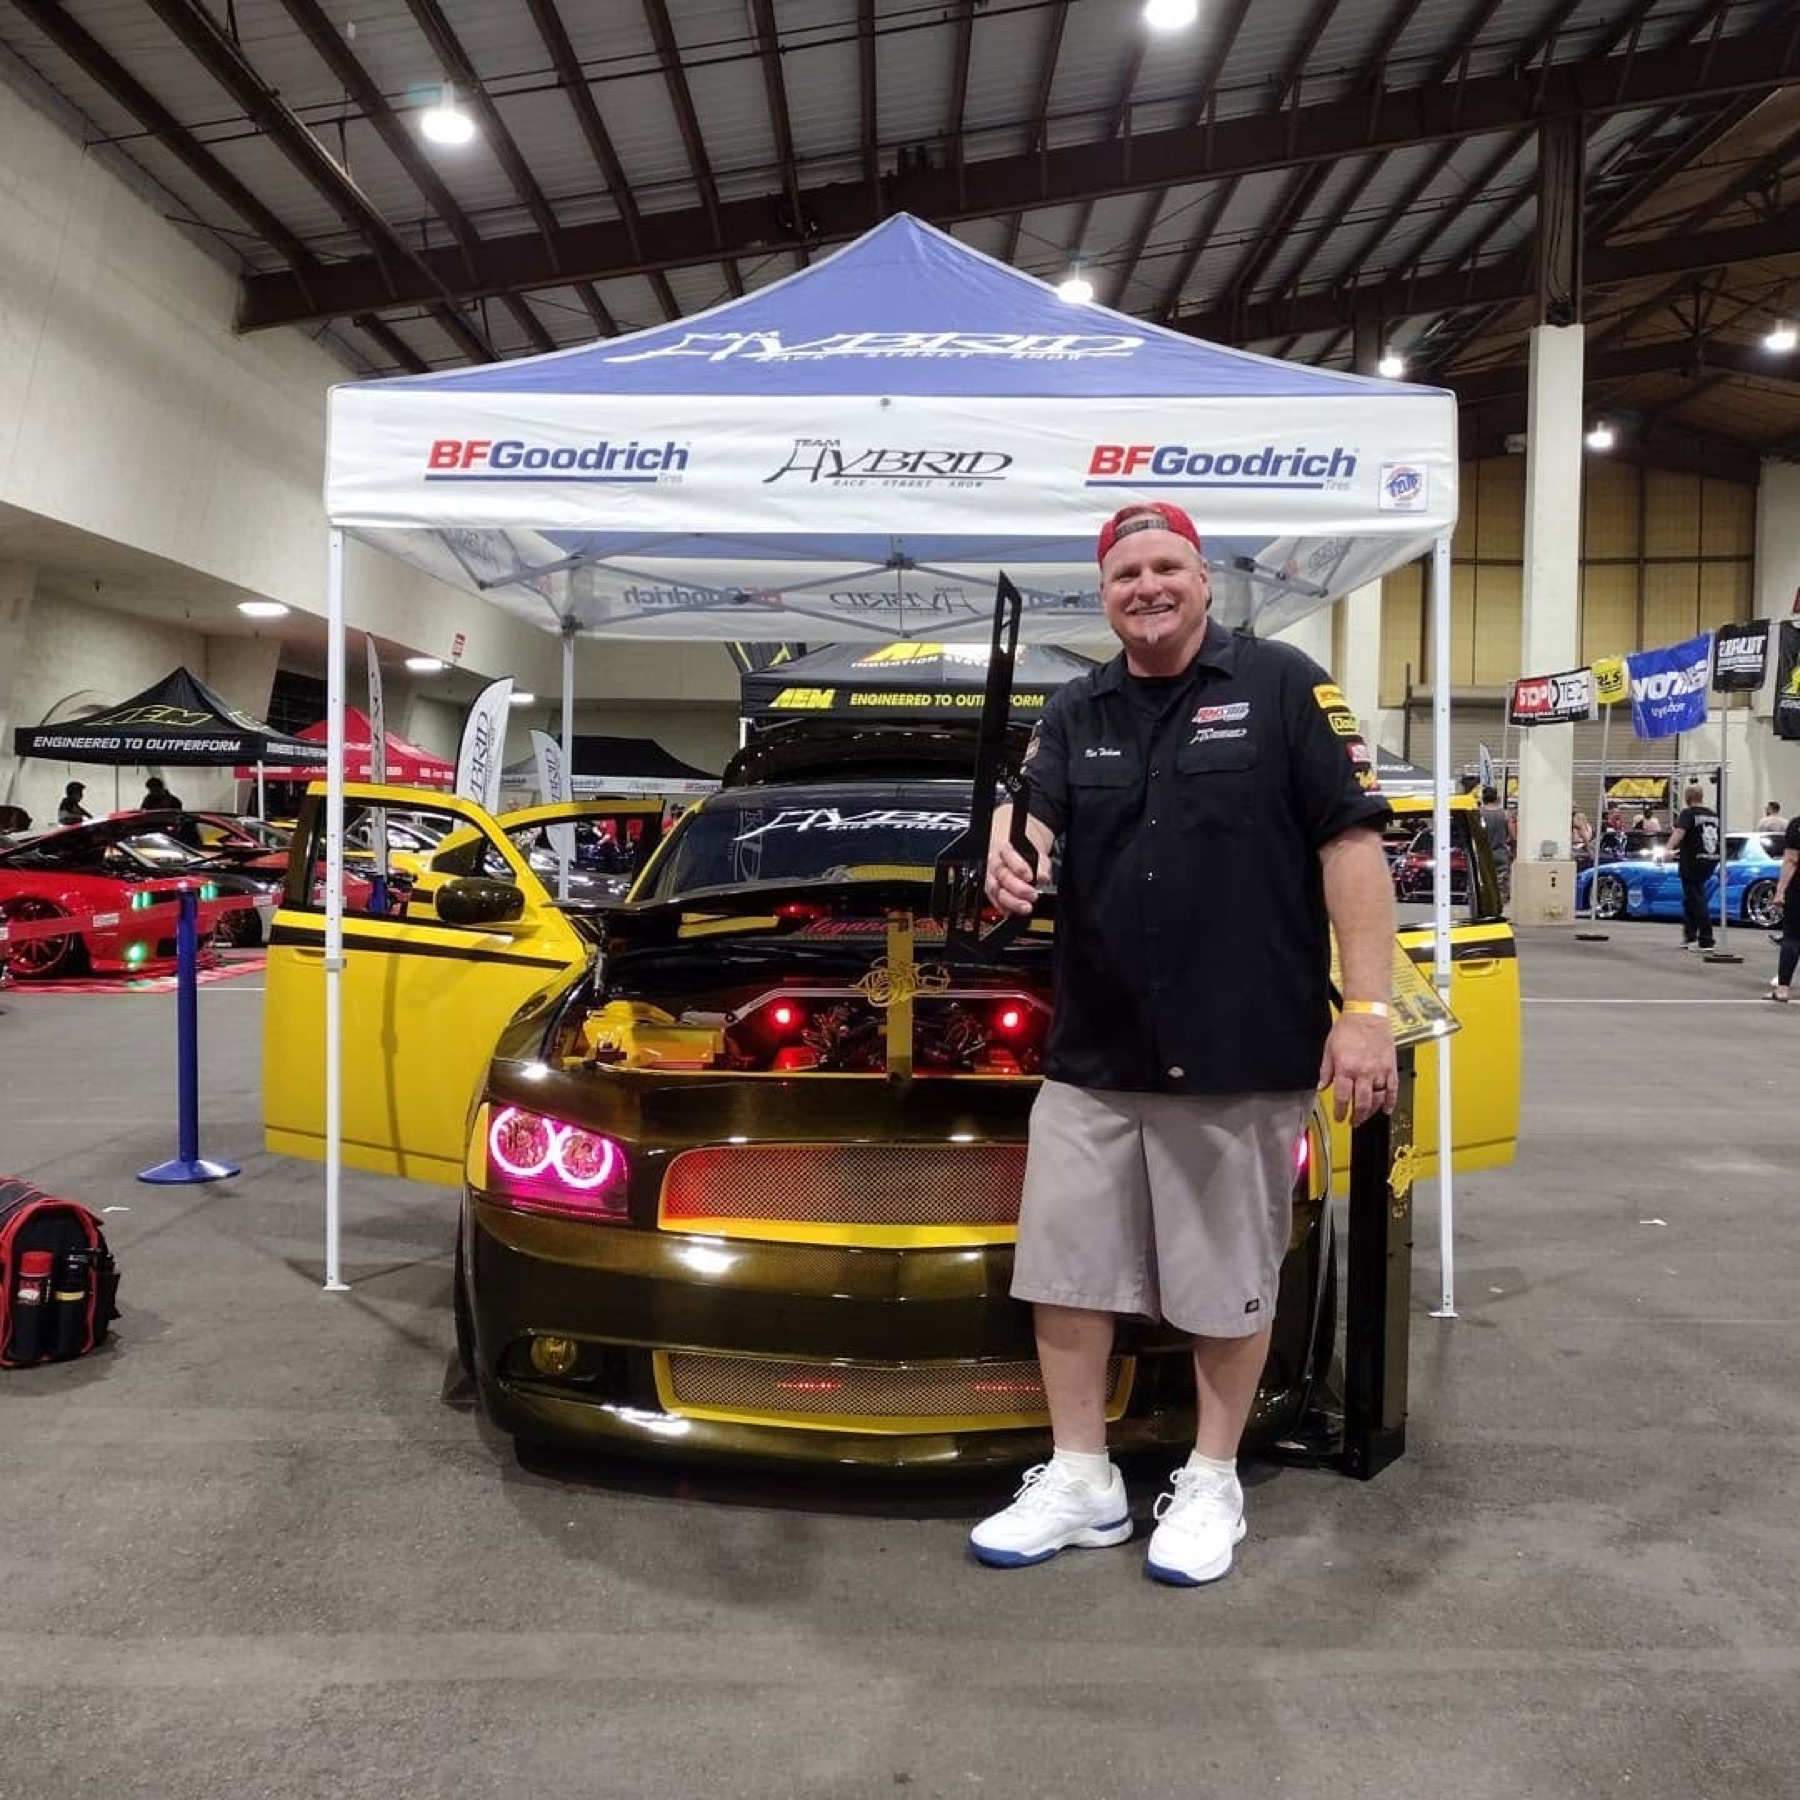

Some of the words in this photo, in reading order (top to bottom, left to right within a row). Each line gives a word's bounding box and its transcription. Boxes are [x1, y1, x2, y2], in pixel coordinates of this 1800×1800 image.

[795, 439, 841, 448] TEAM
[427, 440, 689, 471] BFGoodrich
[1088, 445, 1357, 478] BFGoodrich
[882, 480, 933, 488] STREET
[1323, 480, 1351, 491] Tires
[769, 688, 837, 709] AEM
[849, 692, 931, 706] ENGINEERED
[935, 693, 953, 706] TO
[33, 736, 121, 749] ENGINEERED
[125, 738, 144, 749] TO
[146, 739, 241, 752] OUTPERFORM
